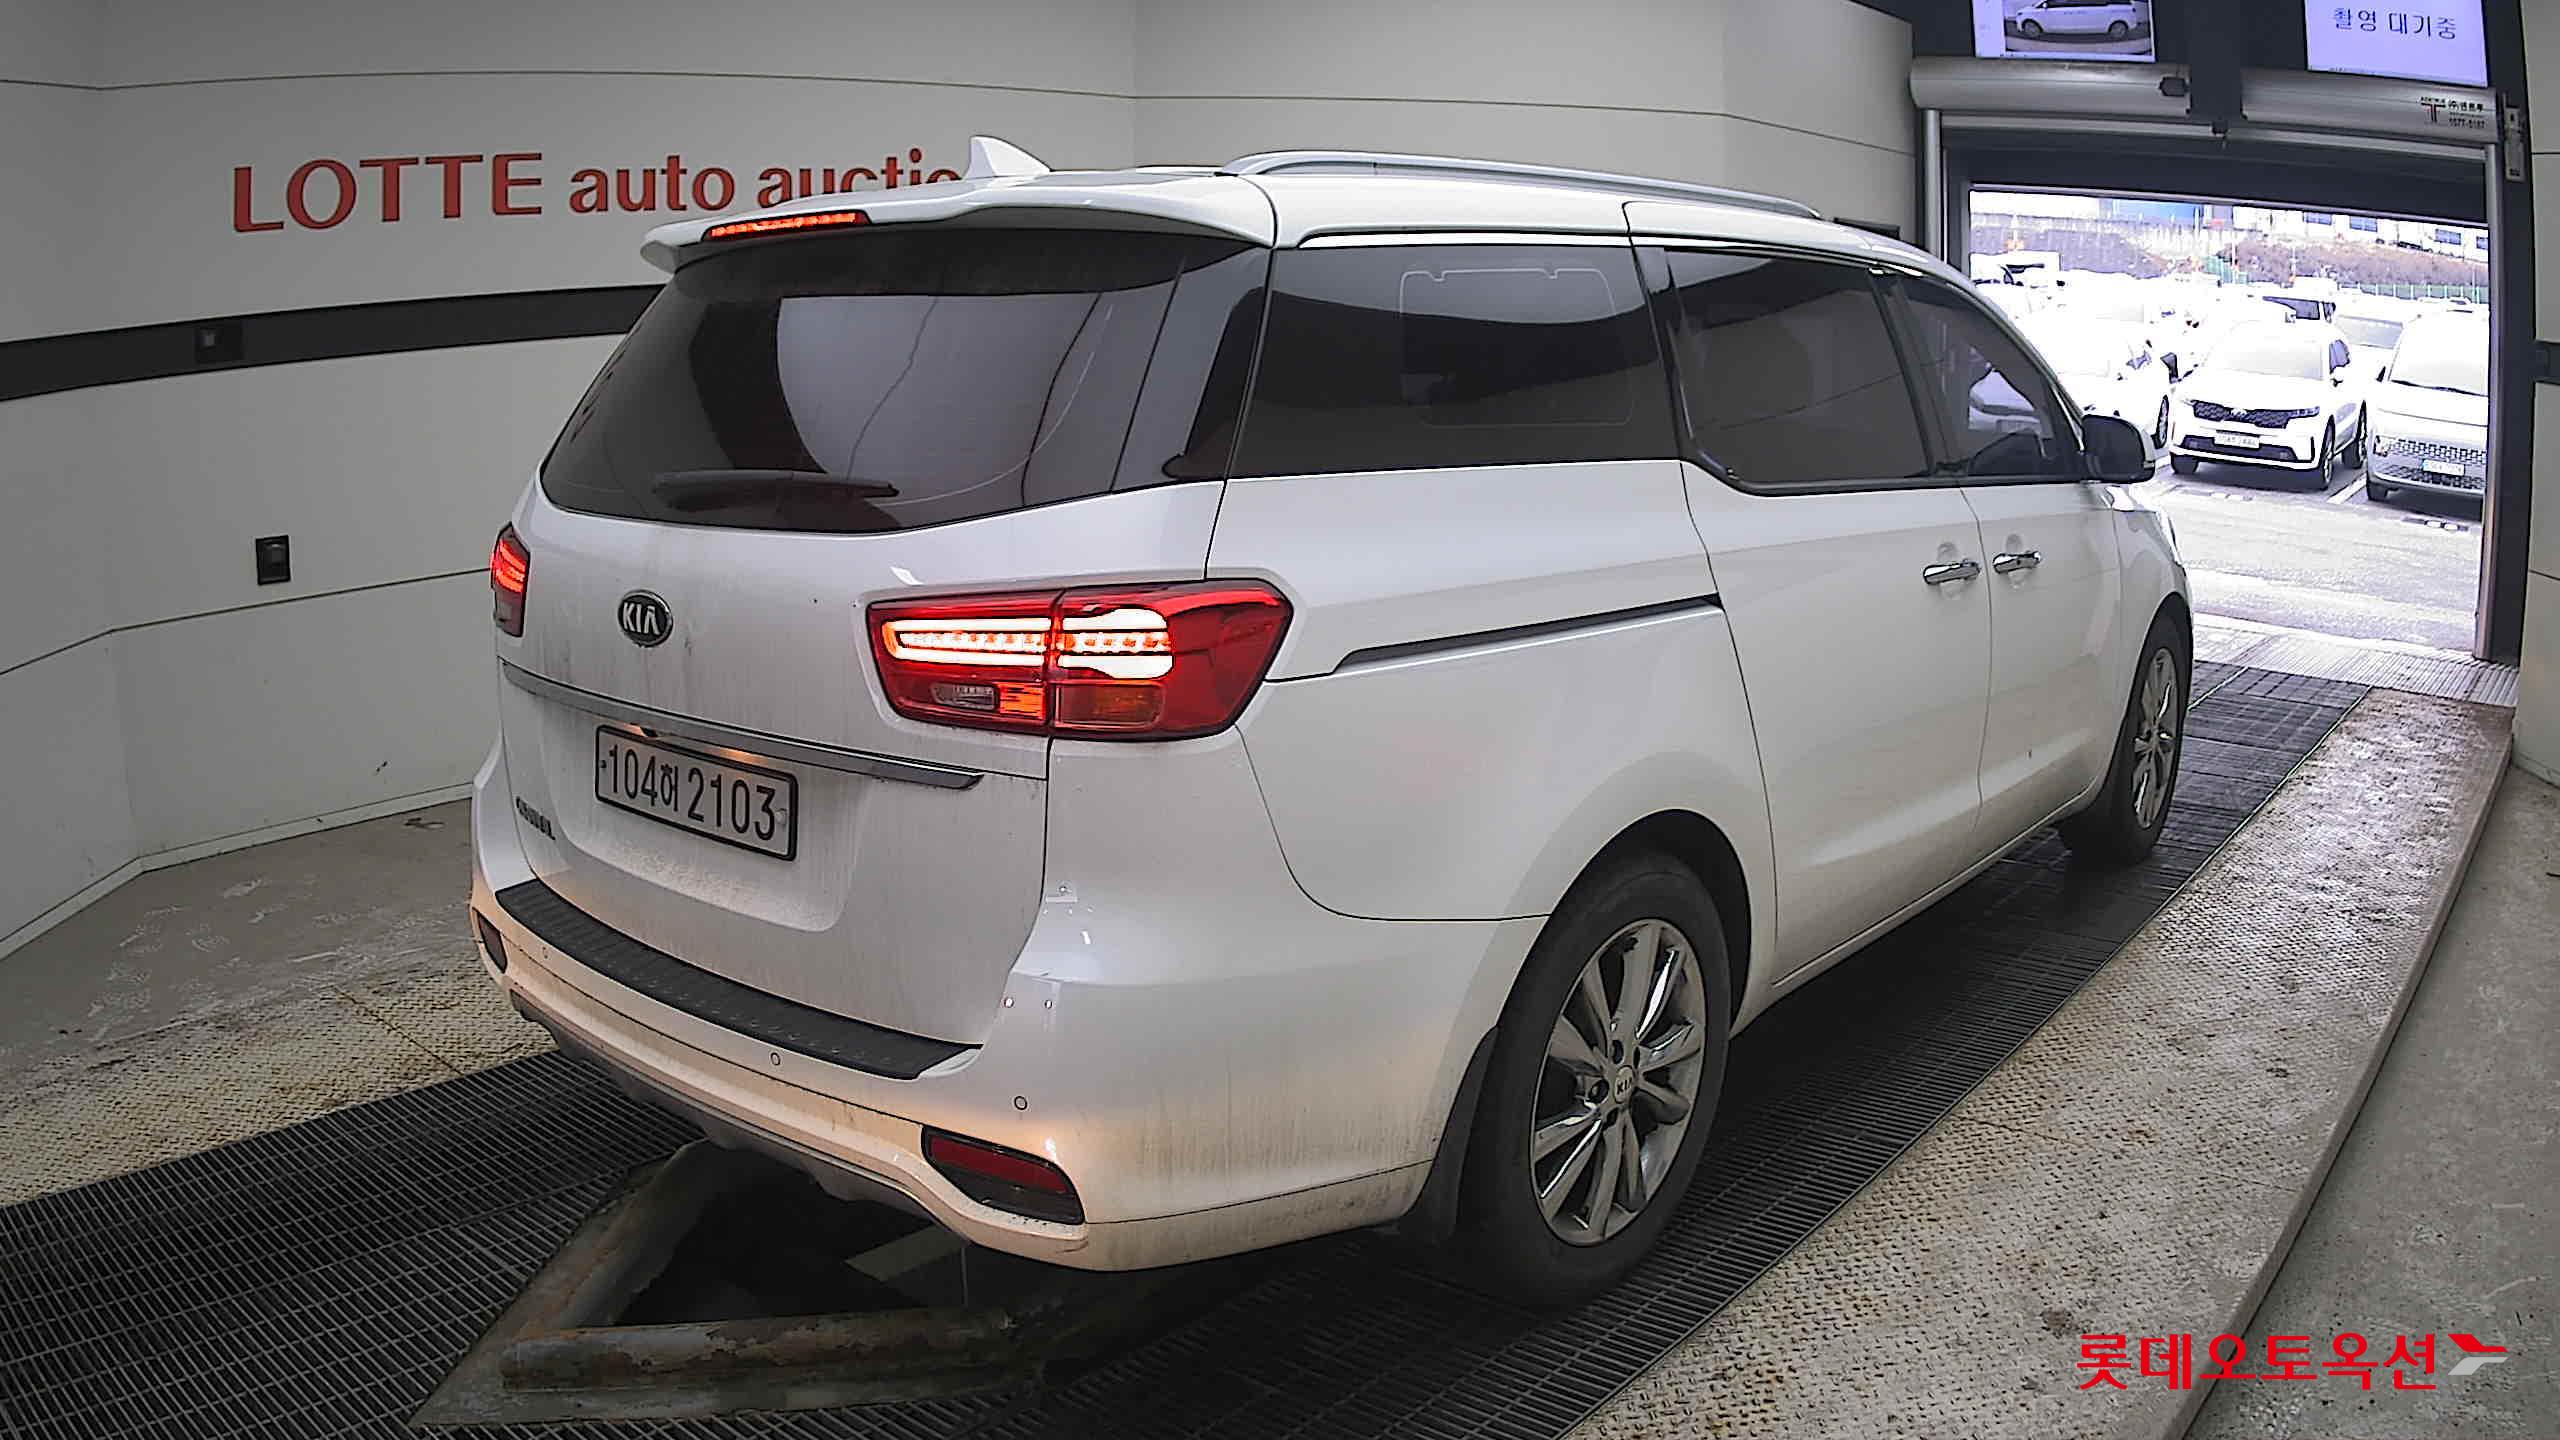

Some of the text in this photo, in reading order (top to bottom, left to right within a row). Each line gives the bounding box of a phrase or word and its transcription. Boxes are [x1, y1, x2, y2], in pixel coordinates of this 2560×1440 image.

[2388, 12, 2457, 40] 대기중
[231, 152, 543, 233] LOTTE
[568, 154, 736, 214] auto
[622, 600, 662, 636] KIA
